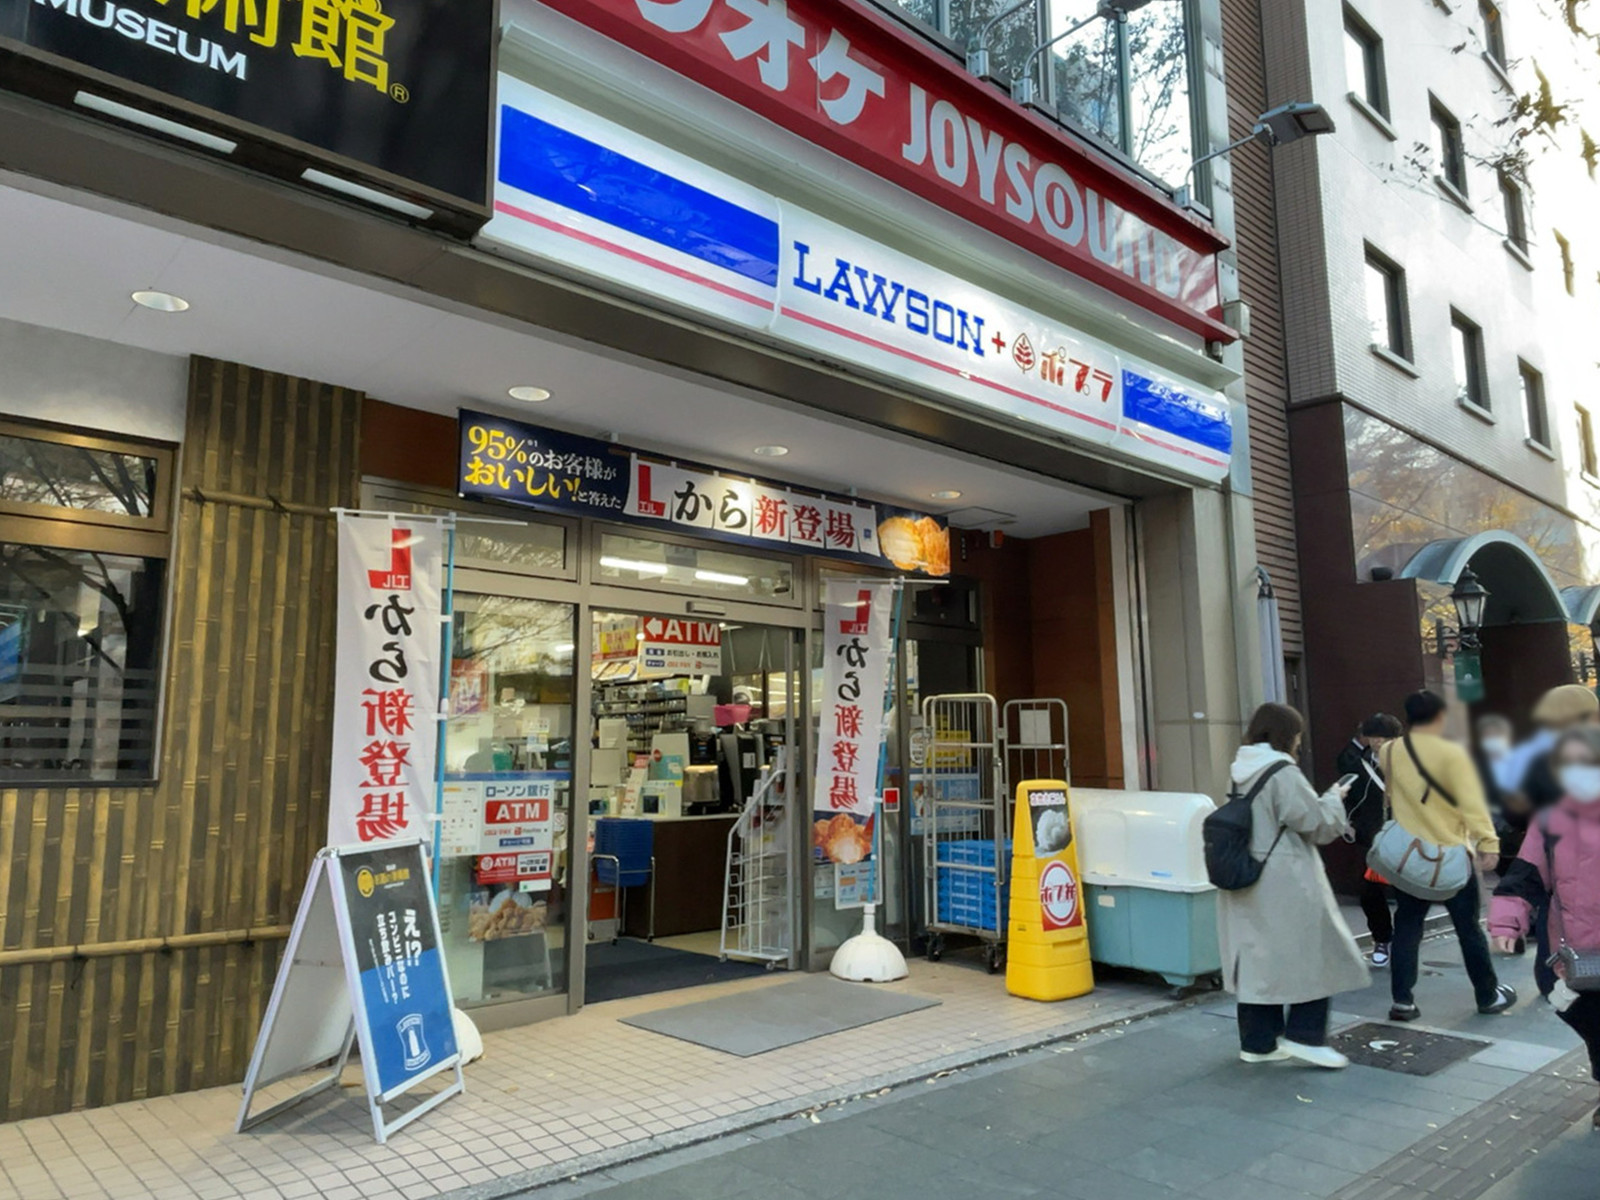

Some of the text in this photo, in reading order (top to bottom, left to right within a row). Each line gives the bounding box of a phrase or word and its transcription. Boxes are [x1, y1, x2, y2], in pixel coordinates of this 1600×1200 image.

[793, 240, 985, 357] LAWSON
[664, 619, 719, 643] ATM
[486, 785, 550, 798] ローソン銀行
[496, 803, 540, 820] ATM
[494, 856, 516, 867] ATM
